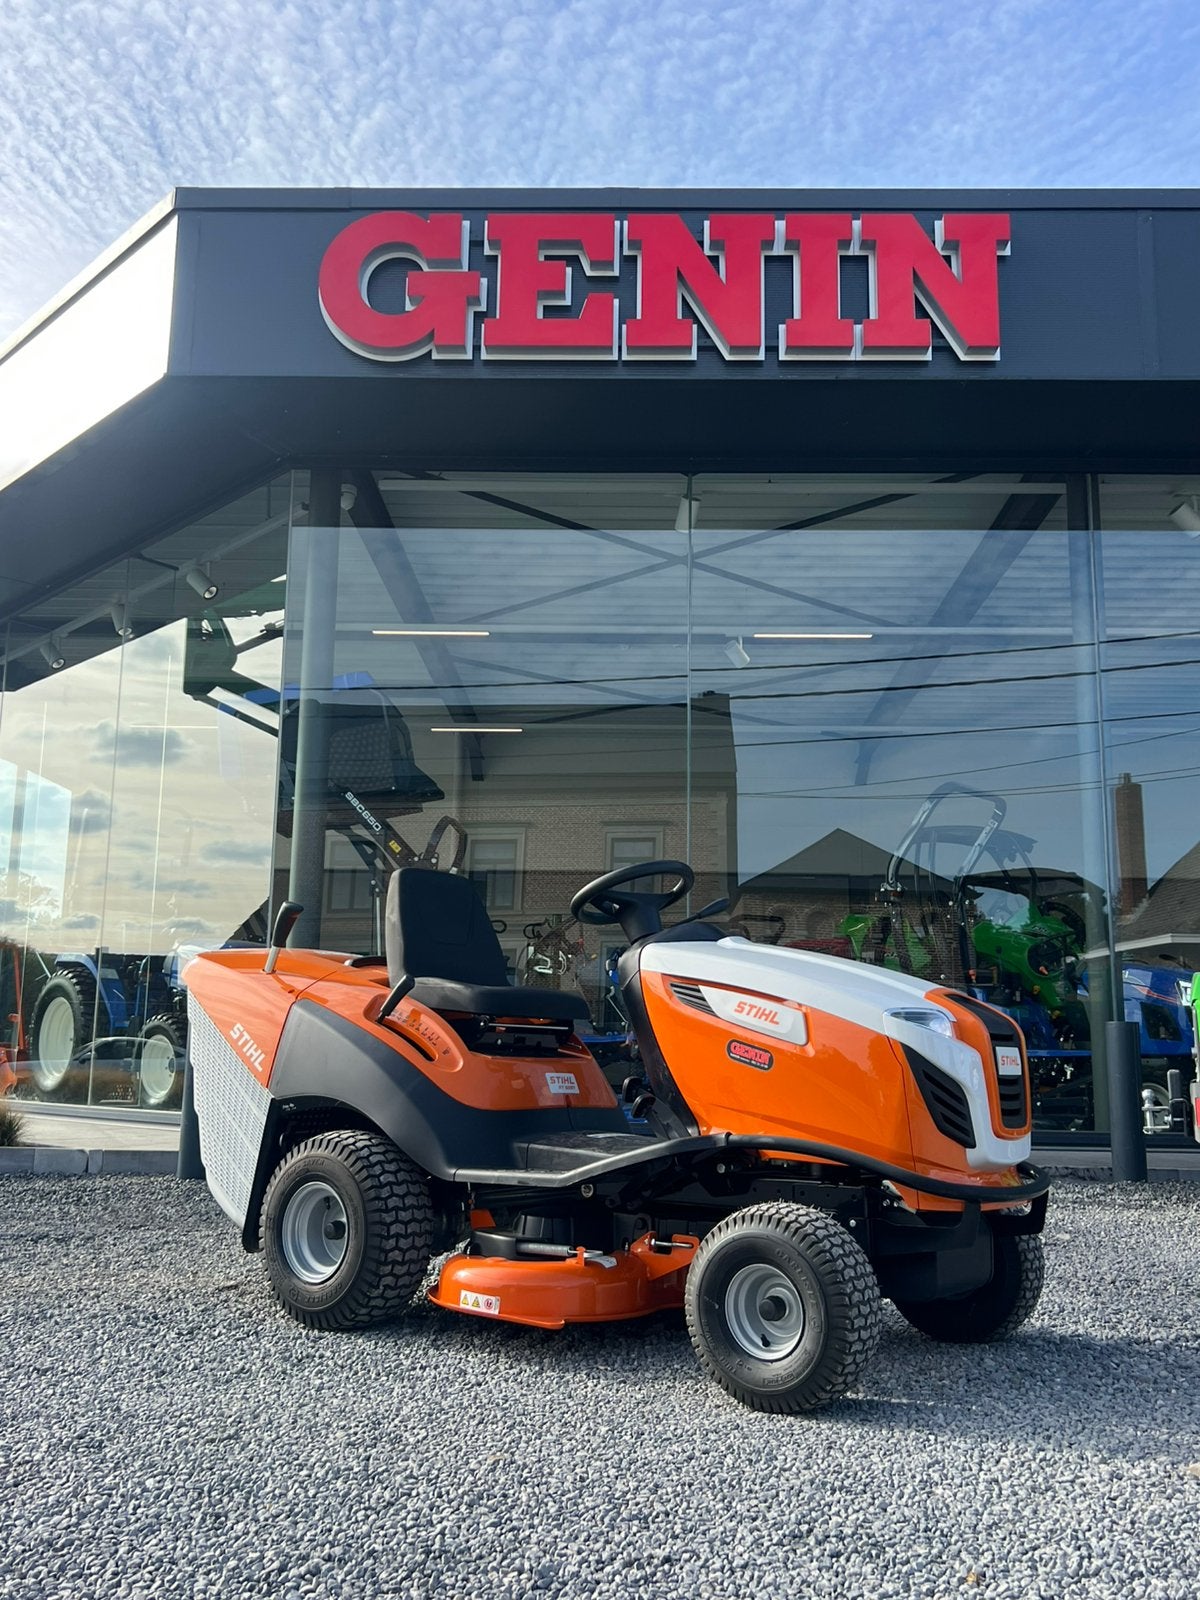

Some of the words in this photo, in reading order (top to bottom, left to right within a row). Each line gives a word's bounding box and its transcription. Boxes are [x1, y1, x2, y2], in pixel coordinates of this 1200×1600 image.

[318, 211, 1011, 363] GENIN
[345, 791, 382, 832] SBC650
[734, 1001, 780, 1025] STIHL
[230, 1023, 266, 1072] STIHL
[1000, 1055, 1020, 1066] STIHL
[550, 1076, 575, 1085] STIHL
